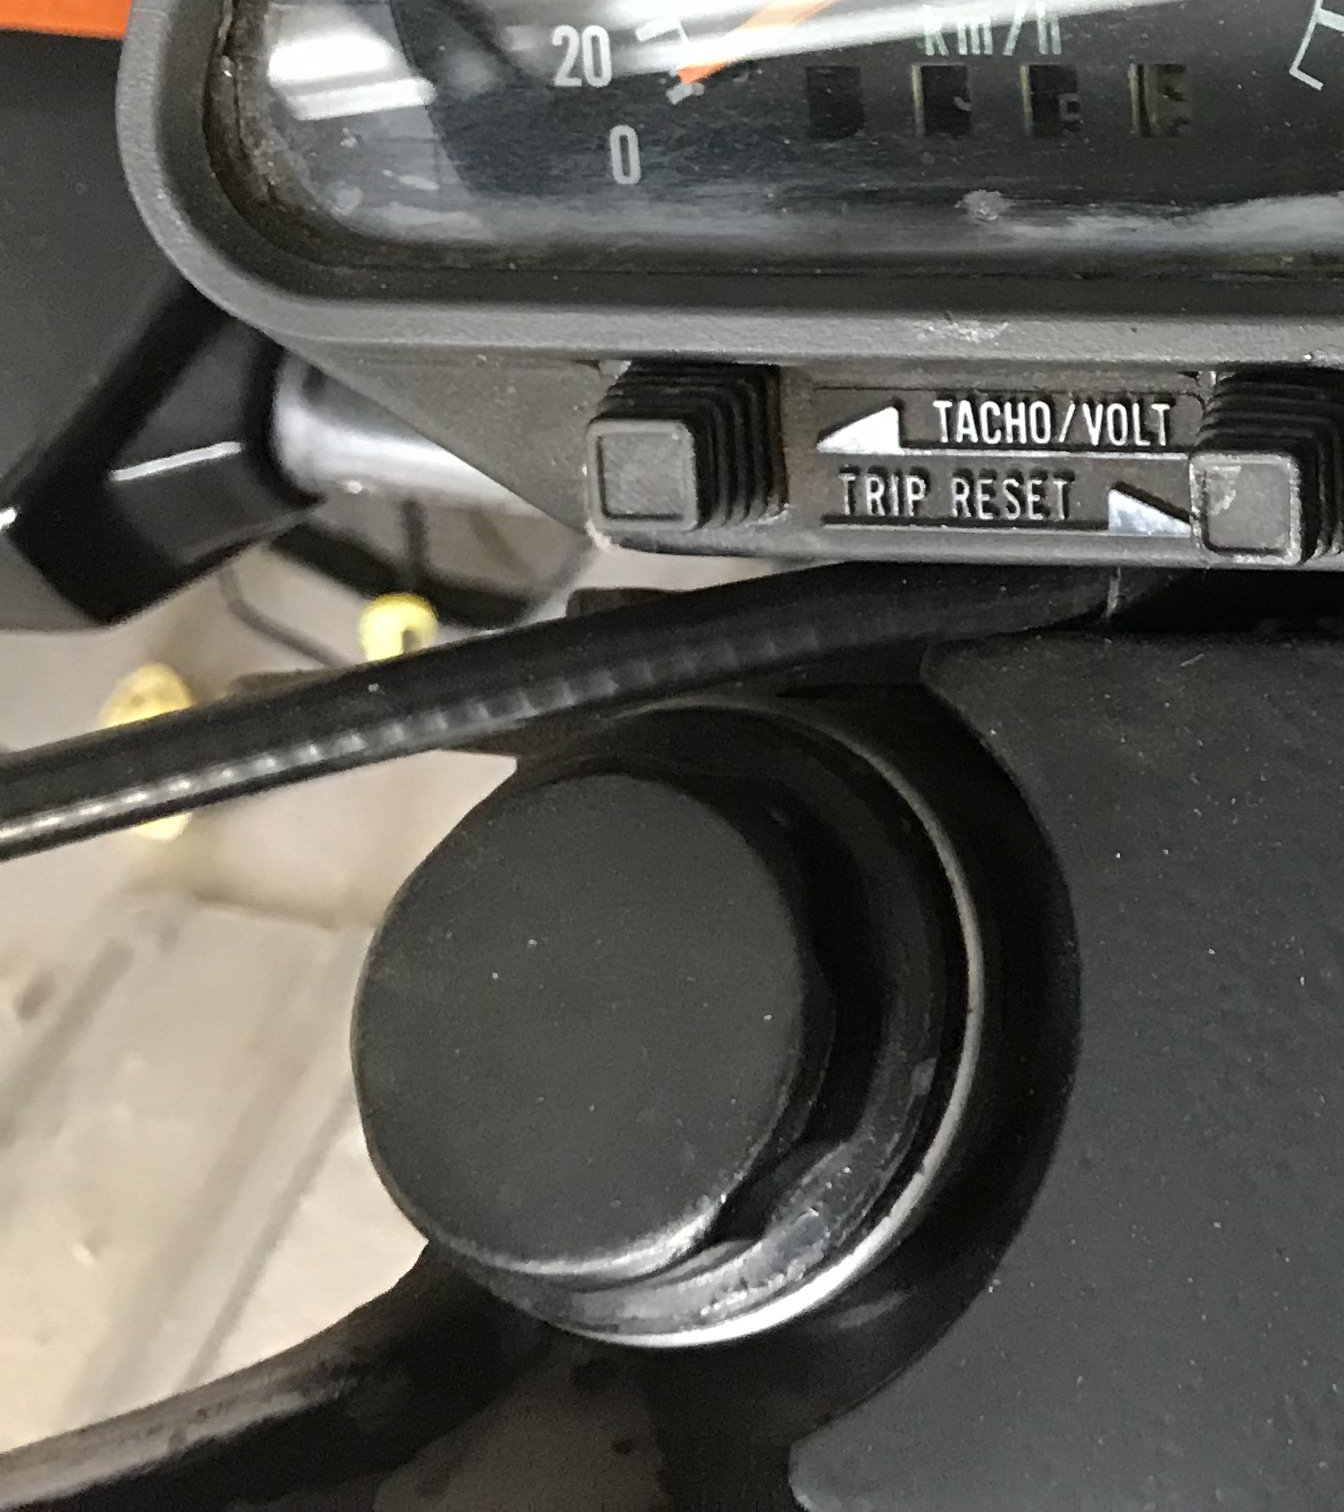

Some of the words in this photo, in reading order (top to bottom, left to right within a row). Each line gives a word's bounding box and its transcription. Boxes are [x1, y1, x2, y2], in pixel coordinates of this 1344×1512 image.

[551, 24, 613, 88] 20
[920, 0, 1063, 57] km/h
[608, 124, 642, 186] 0
[931, 398, 1176, 448] TACHO/VOLT
[837, 471, 929, 519] TRIP
[950, 471, 1073, 523] RESET
